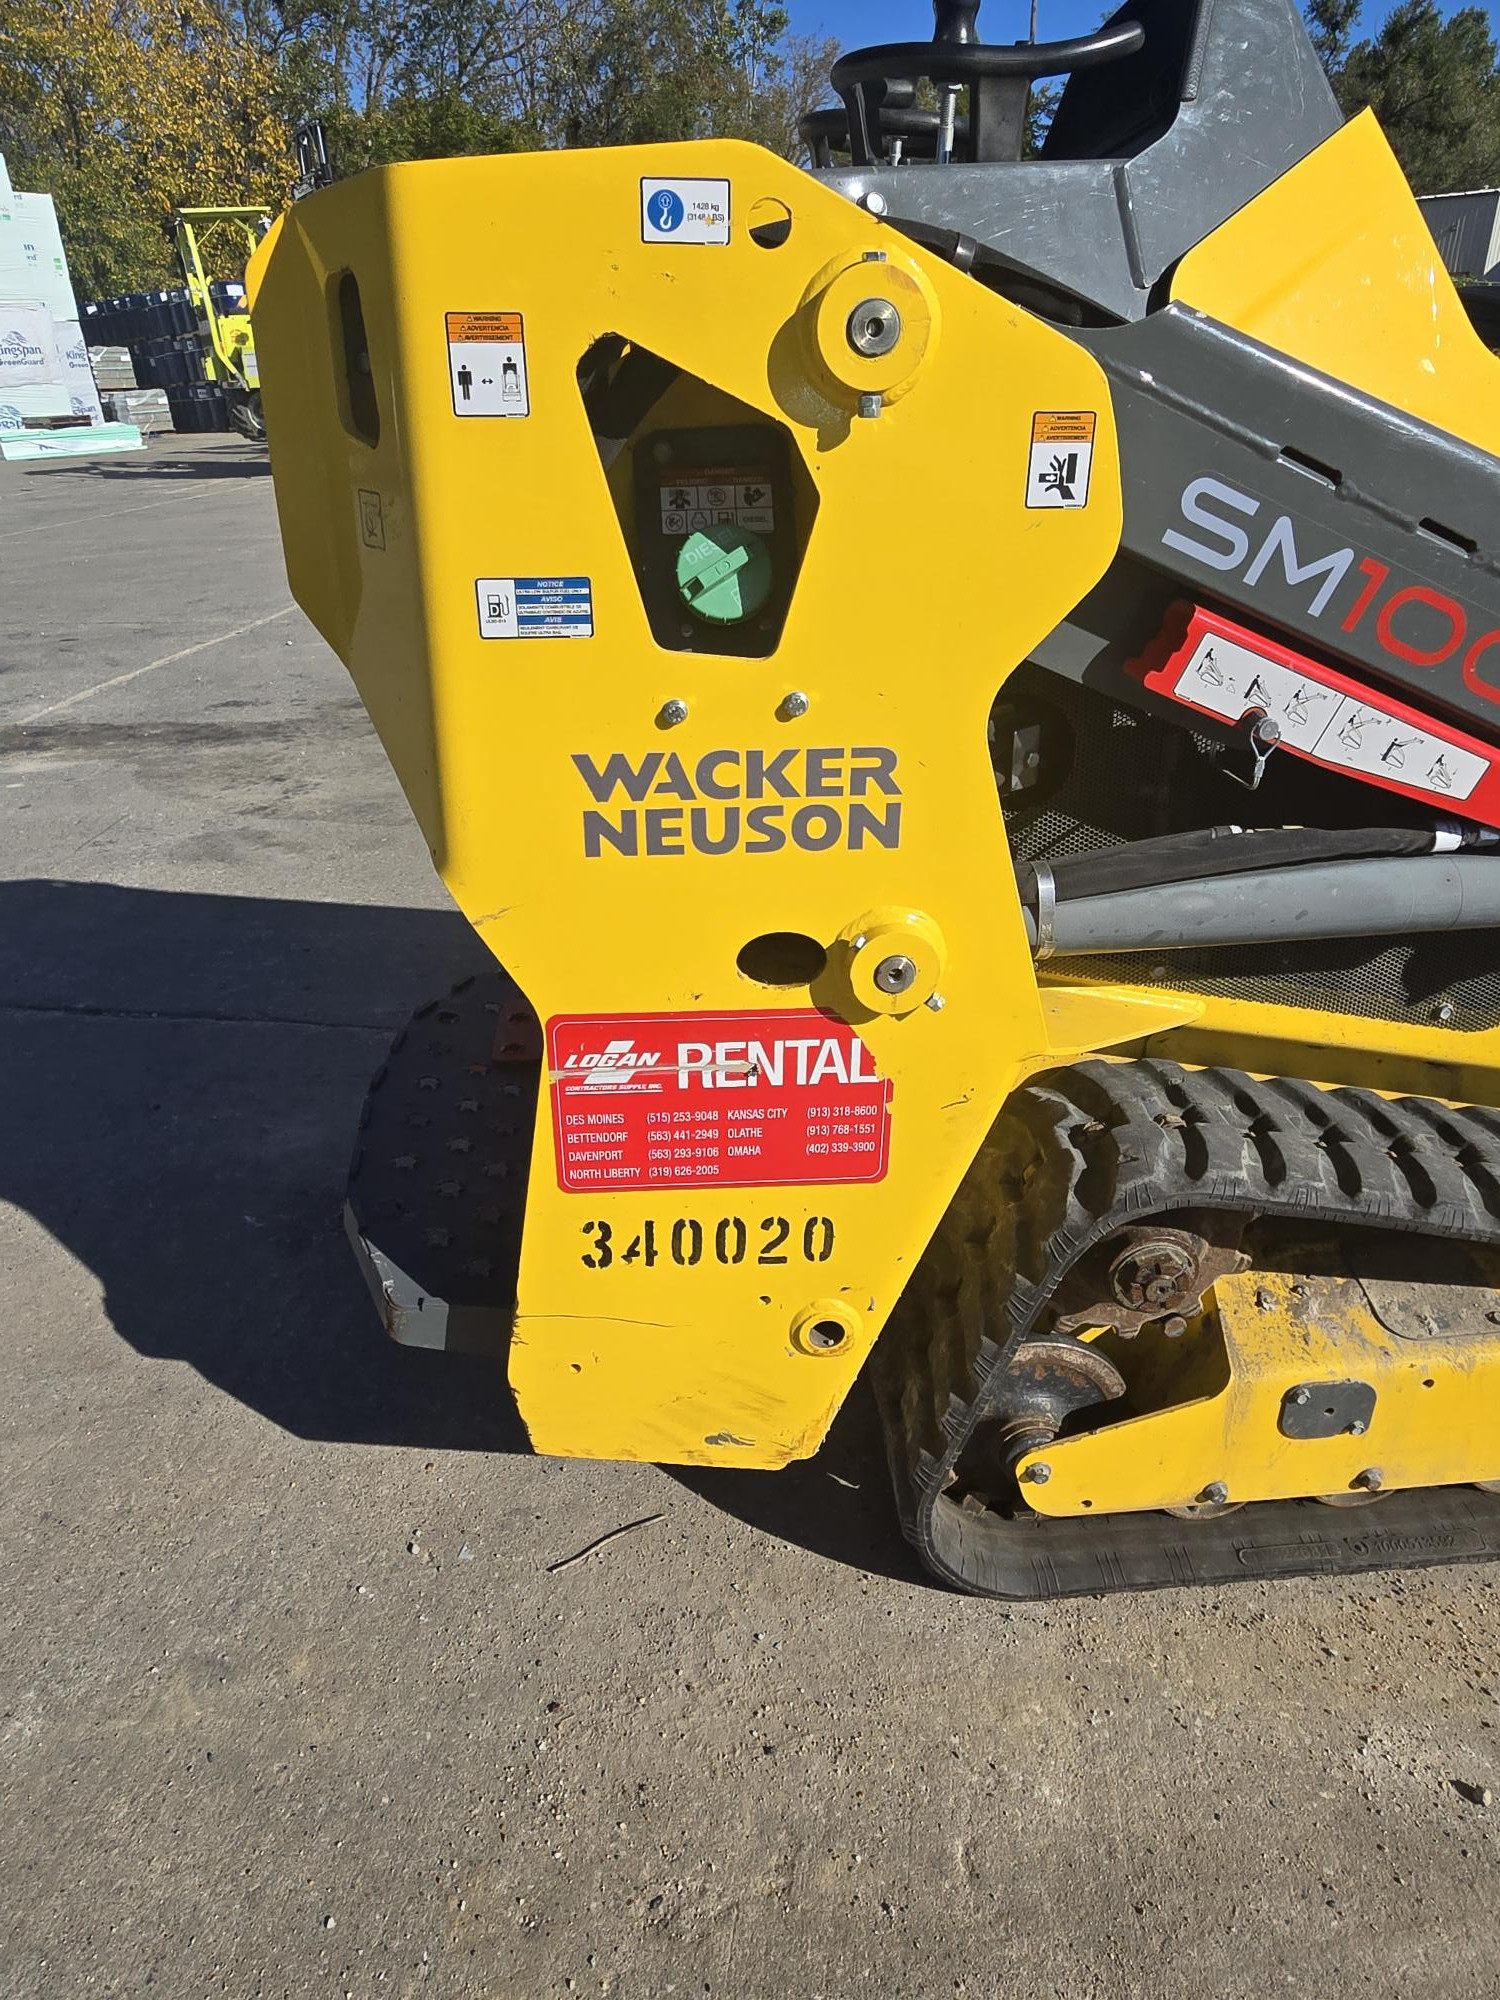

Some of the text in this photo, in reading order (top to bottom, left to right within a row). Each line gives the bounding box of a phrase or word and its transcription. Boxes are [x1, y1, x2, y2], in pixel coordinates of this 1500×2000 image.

[692, 202, 720, 212] 1428 kg
[0, 345, 42, 358] ingspan
[570, 747, 903, 804] WACKER
[582, 802, 903, 858] NEUSON
[563, 1051, 662, 1069] LOGAN
[677, 1037, 881, 1090] RENTAL
[566, 1110, 719, 1126] DES MOINES (515) 253-9048
[727, 1105, 878, 1120] KANSAS CITY (913) 318-8600
[567, 1128, 719, 1144] BETTENDORF (563) 441-2949
[727, 1123, 876, 1139] OLATHE (913) 768-1551
[568, 1147, 719, 1162] DAVENPORT (563) 293-9106
[727, 1141, 876, 1157] OMAHA (402) 339-3900
[569, 1165, 720, 1180] NORTH LIBERTY (319) 626-2005
[580, 1216, 836, 1270] 340020
